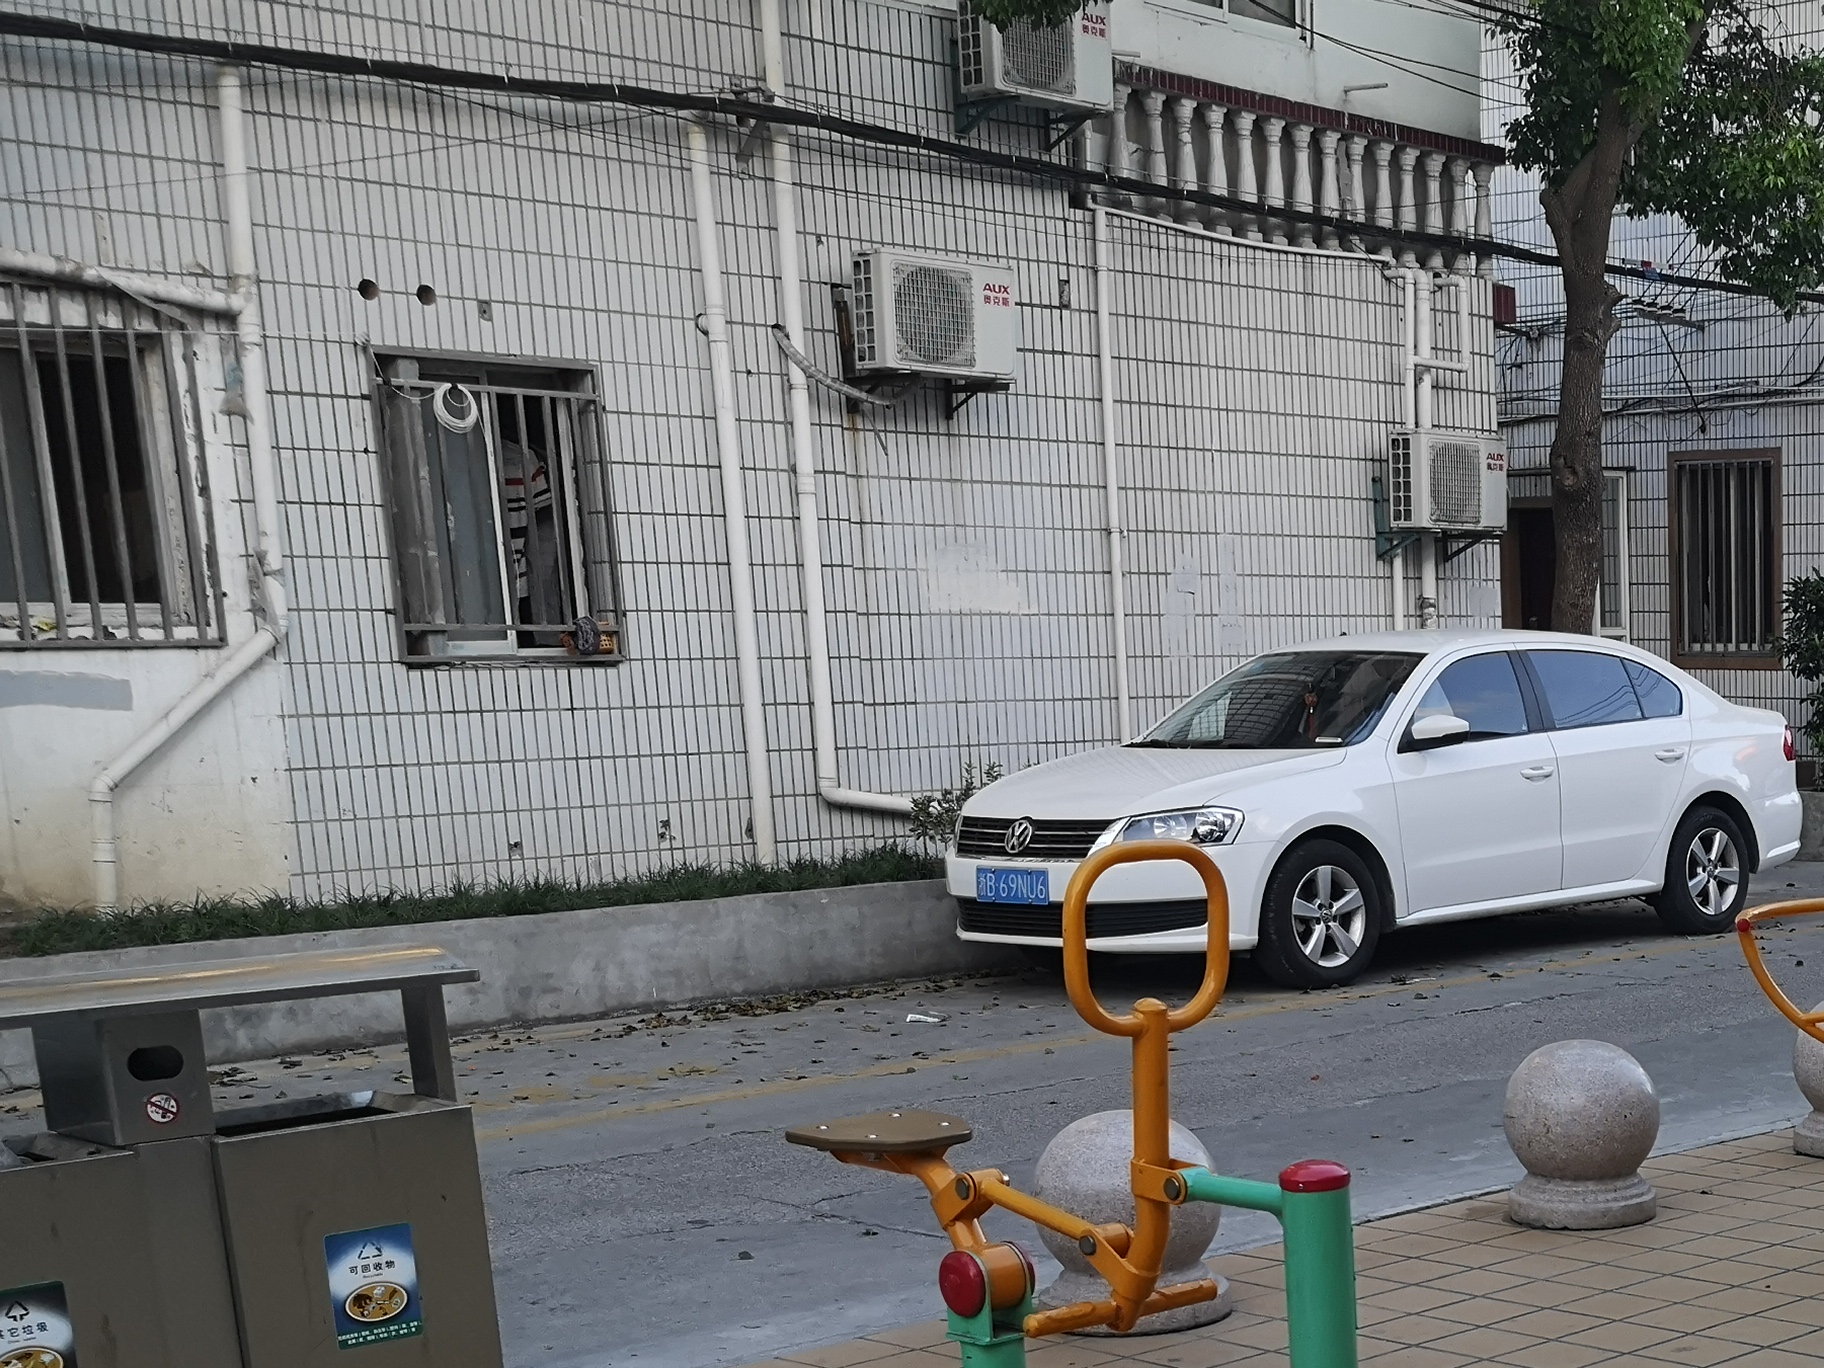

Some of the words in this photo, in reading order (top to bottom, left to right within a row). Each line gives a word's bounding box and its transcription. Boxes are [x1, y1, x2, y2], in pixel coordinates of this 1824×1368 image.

[1082, 13, 1106, 26] AUX
[983, 283, 1010, 295] AUX
[984, 295, 1010, 307] 奥克斯
[1487, 453, 1504, 462] AUX
[348, 1260, 396, 1275] 可回收物
